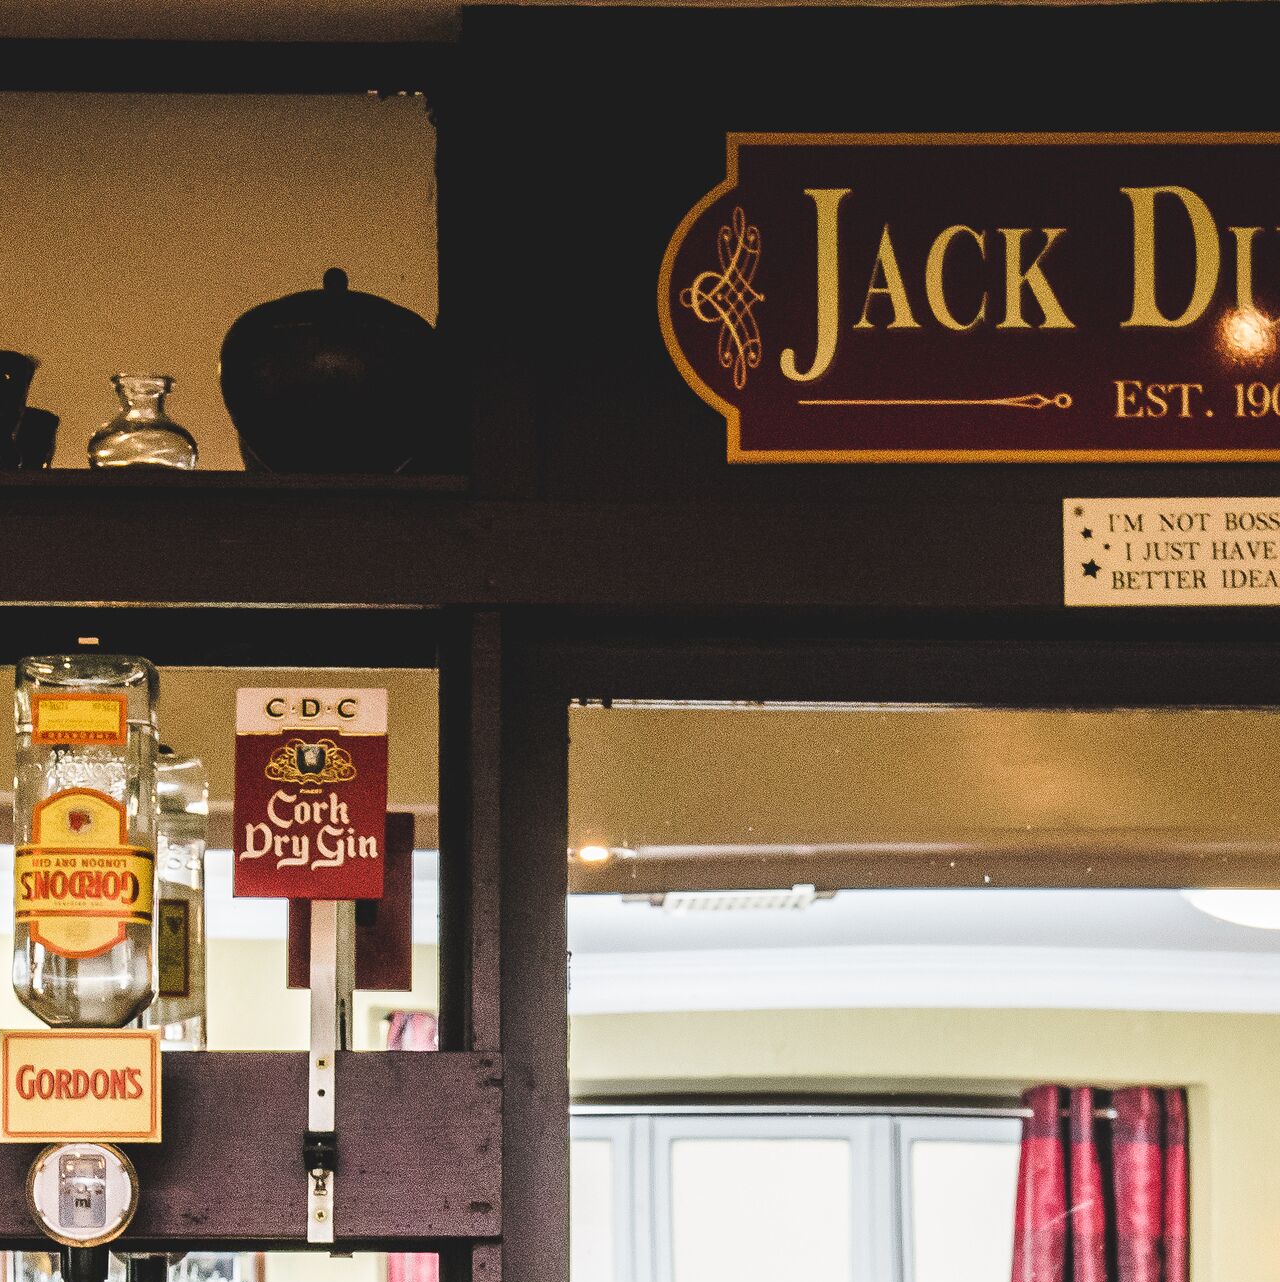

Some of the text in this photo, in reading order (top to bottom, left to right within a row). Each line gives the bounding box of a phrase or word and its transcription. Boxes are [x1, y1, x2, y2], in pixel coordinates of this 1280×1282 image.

[780, 188, 1078, 383] JACK
[1114, 379, 1217, 419] EST.
[1108, 513, 1143, 533] I'M
[1159, 512, 1211, 532] NOT
[1125, 540, 1278, 561] I JUST HAVE
[1111, 570, 1207, 590] BETTER
[267, 789, 350, 829] Cork
[239, 822, 379, 871] Dry Gin
[31, 858, 127, 869] LONDON DRY GIN
